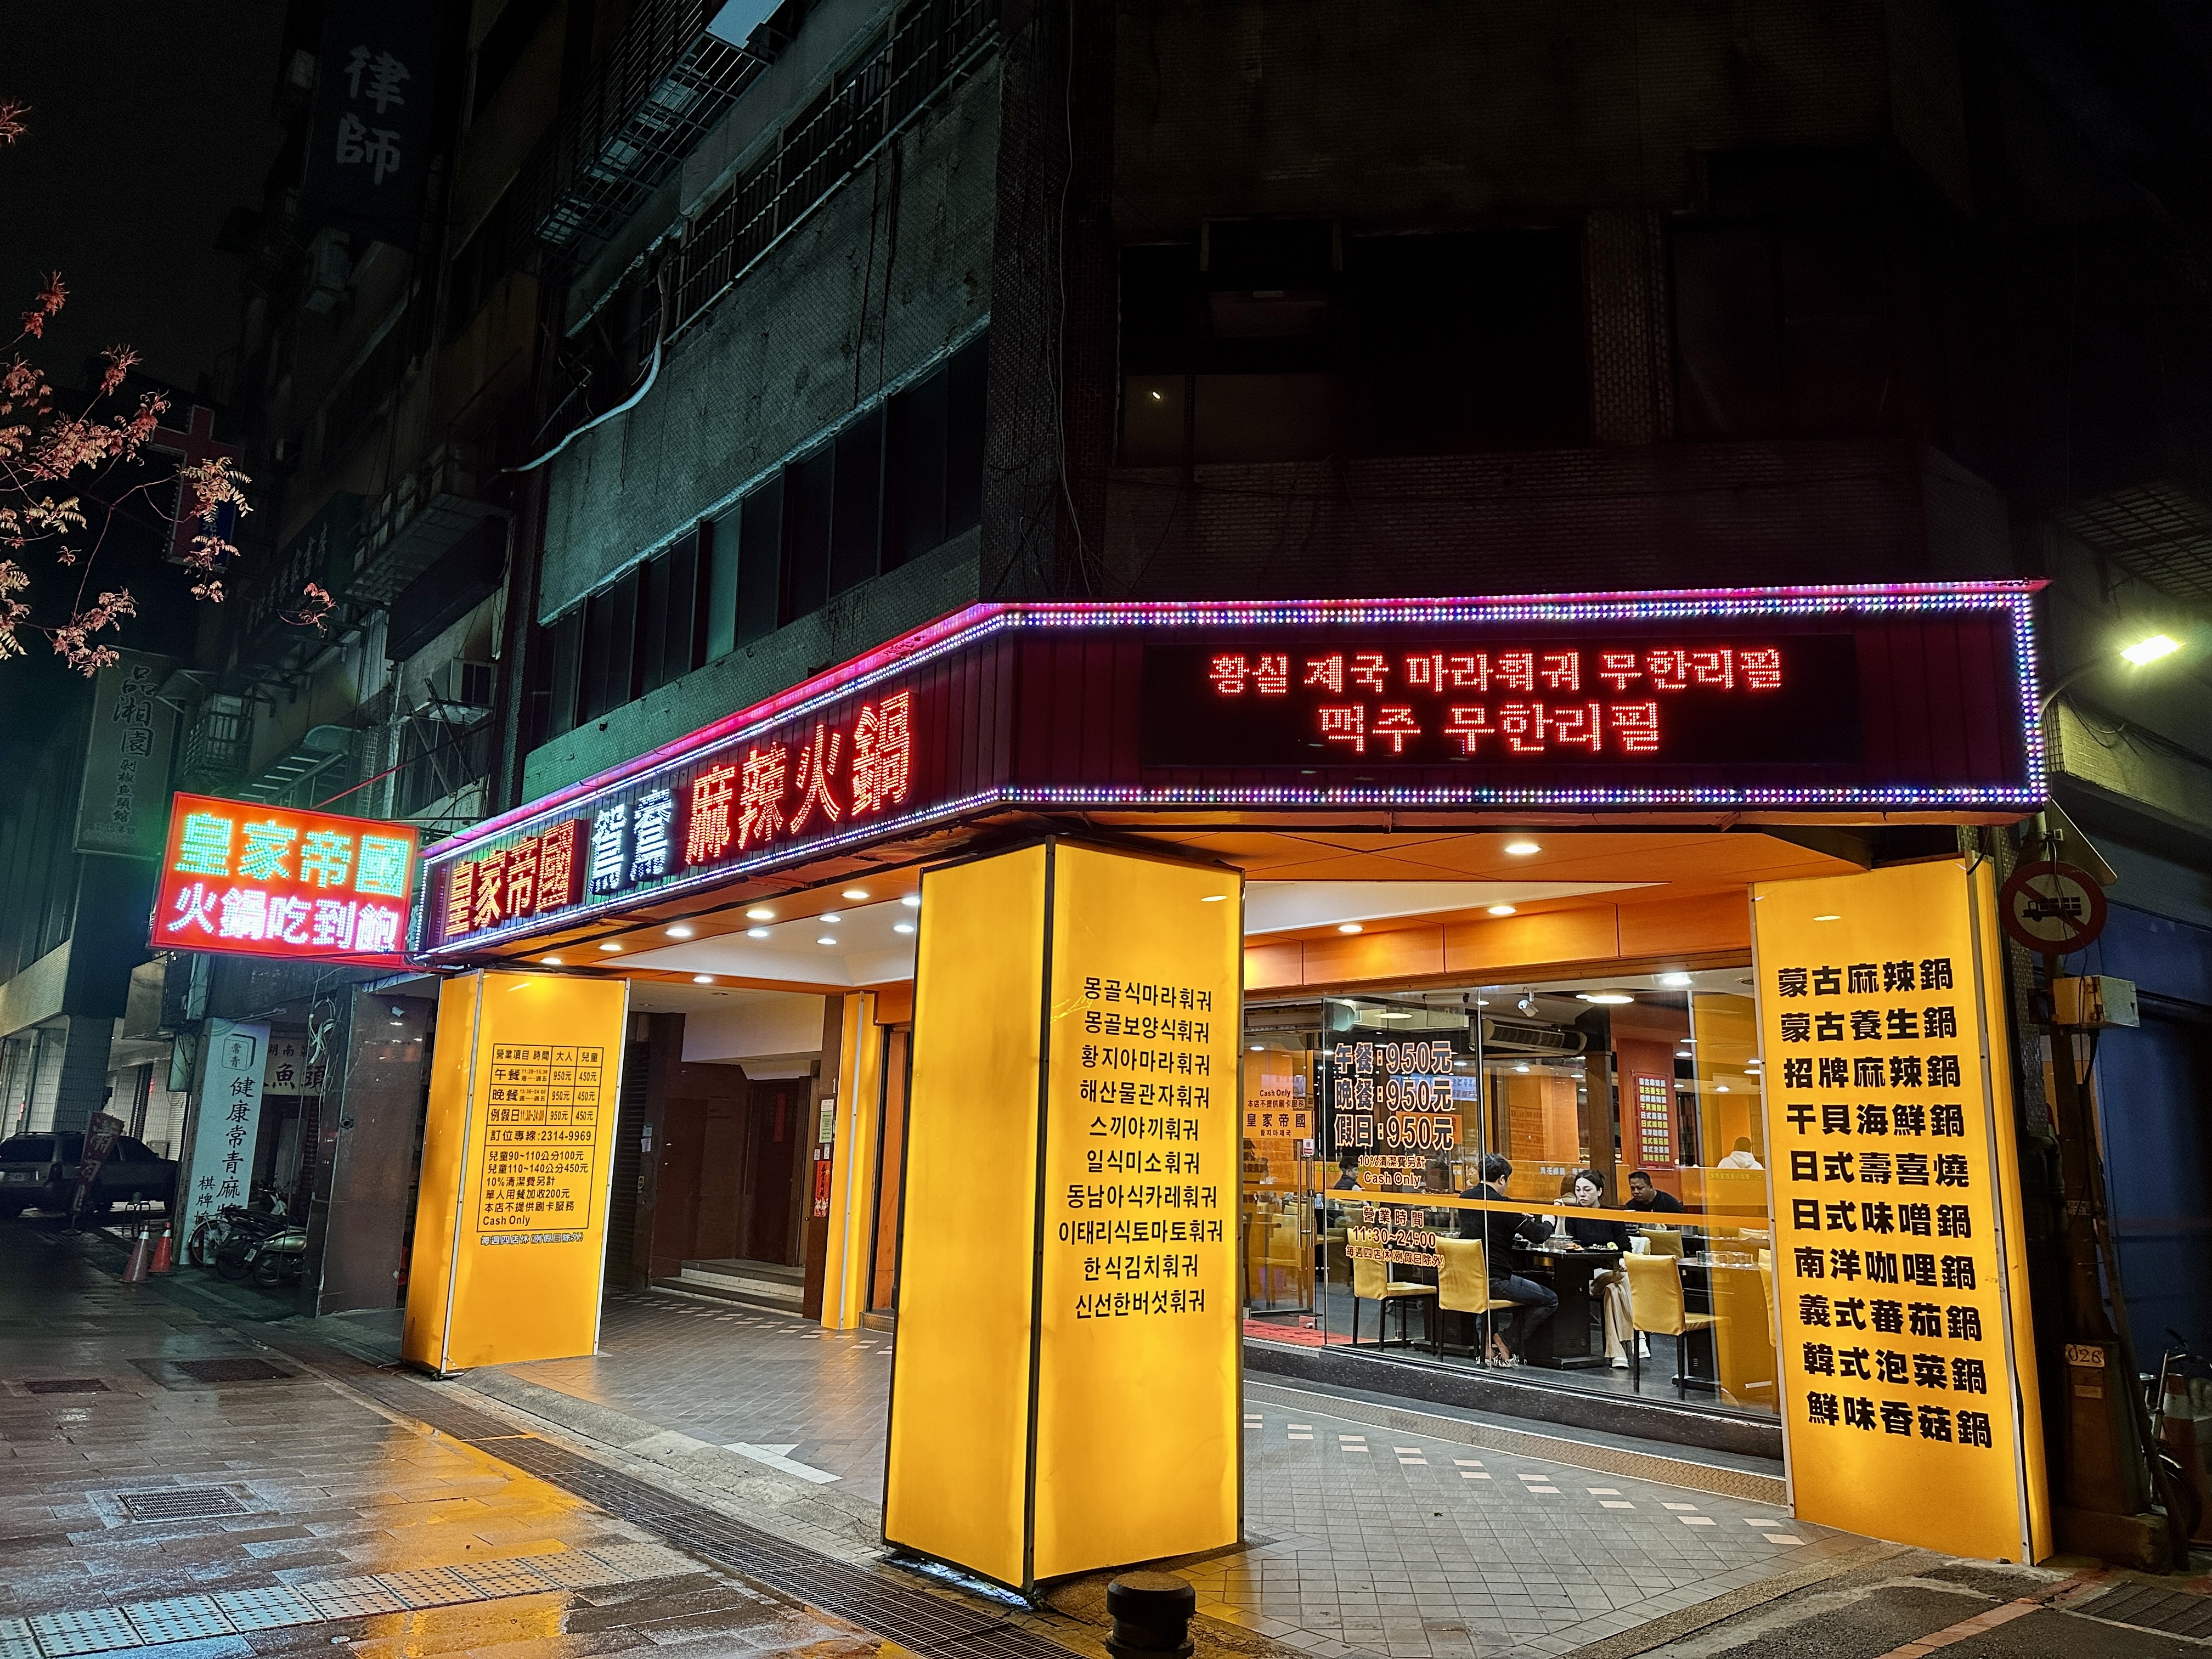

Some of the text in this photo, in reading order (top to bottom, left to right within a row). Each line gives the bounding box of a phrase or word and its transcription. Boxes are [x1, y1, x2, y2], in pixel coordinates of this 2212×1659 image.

[336, 44, 411, 185] 律師
[1209, 649, 1782, 693] 황실 제국 마라훠궈 무한리필
[112, 664, 159, 757] 品湘園
[1318, 702, 1660, 752] 맥주 무한리필
[445, 691, 911, 936] 皇家帝國 鴛鴦 麻辣火鍋
[174, 813, 410, 898] 皇家帝國
[168, 882, 399, 955] 火鍋吃到飽
[1778, 957, 1954, 998] 蒙古麻辣鍋
[1084, 977, 1212, 1012] 몽골식마라훠궈
[1084, 1011, 1209, 1044] 몽골보양식훠궈
[1780, 1006, 1957, 1043] 蒙古養生鍋
[229, 1042, 241, 1068] 常青
[496, 1048, 598, 1062] 營業項目 時間 大人 兒童
[1081, 1045, 1210, 1076] 황지아마라훠궈
[1334, 1040, 1453, 1074] 午餐:950元
[263, 1063, 326, 1089] 魚頭
[494, 1068, 597, 1081] 午餐 950元 450元
[1783, 1054, 1961, 1088] 招牌麻辣鍋
[492, 1089, 595, 1101] 晚餐 950元 450元
[1080, 1079, 1209, 1109] 해산물관자훠궈
[1248, 1099, 1305, 1108] 本店不提供刷卡服務
[1276, 1088, 1291, 1097] Only
[1334, 1078, 1454, 1112] 晚餐:950元
[490, 1108, 520, 1122] 例假日
[550, 1110, 568, 1121] 950元
[575, 1110, 593, 1121] 450元
[1090, 1115, 1199, 1141] 스끼야끼훠궈
[1246, 1113, 1306, 1128] 皇家帝國
[1786, 1104, 1965, 1137] 干貝海鮮鍋
[1334, 1114, 1454, 1151] 假日:950元
[488, 1164, 589, 1174] 兒童110~140公分450元
[489, 1151, 584, 1161] 兒童90~110公分100元
[1087, 1149, 1200, 1175] 일식미소훠궈
[1358, 1154, 1426, 1169] 10%清潔費另計
[1790, 1150, 1970, 1188] 日式壽喜燒
[486, 1188, 570, 1200] 單人用餐加收200元
[487, 1176, 555, 1187] 10%清潔費另計
[1364, 1172, 1421, 1189] Cash Only
[484, 1201, 574, 1213] 本店不提供刷卡服務
[1067, 1184, 1217, 1209] 동남아식카레훠궈
[483, 1215, 531, 1227] Cash Only
[1363, 1206, 1425, 1228] 營業時間
[1792, 1198, 1972, 1239] 日式味噌鍋
[1059, 1220, 1223, 1245] 이태리식토마토훠궈
[1353, 1225, 1437, 1249] 11:30~24:00
[1084, 1254, 1198, 1282] 한식김치훠궈
[1794, 1246, 1977, 1290] 南洋咖哩鍋
[1075, 1289, 1205, 1319] 신선한버섯훠궈
[1799, 1294, 1983, 1342] 義式蕃茄鍋
[1802, 1342, 1988, 1395] 韓式泡菜鍋
[1806, 1391, 1993, 1448] 鮮味香菇鍋
